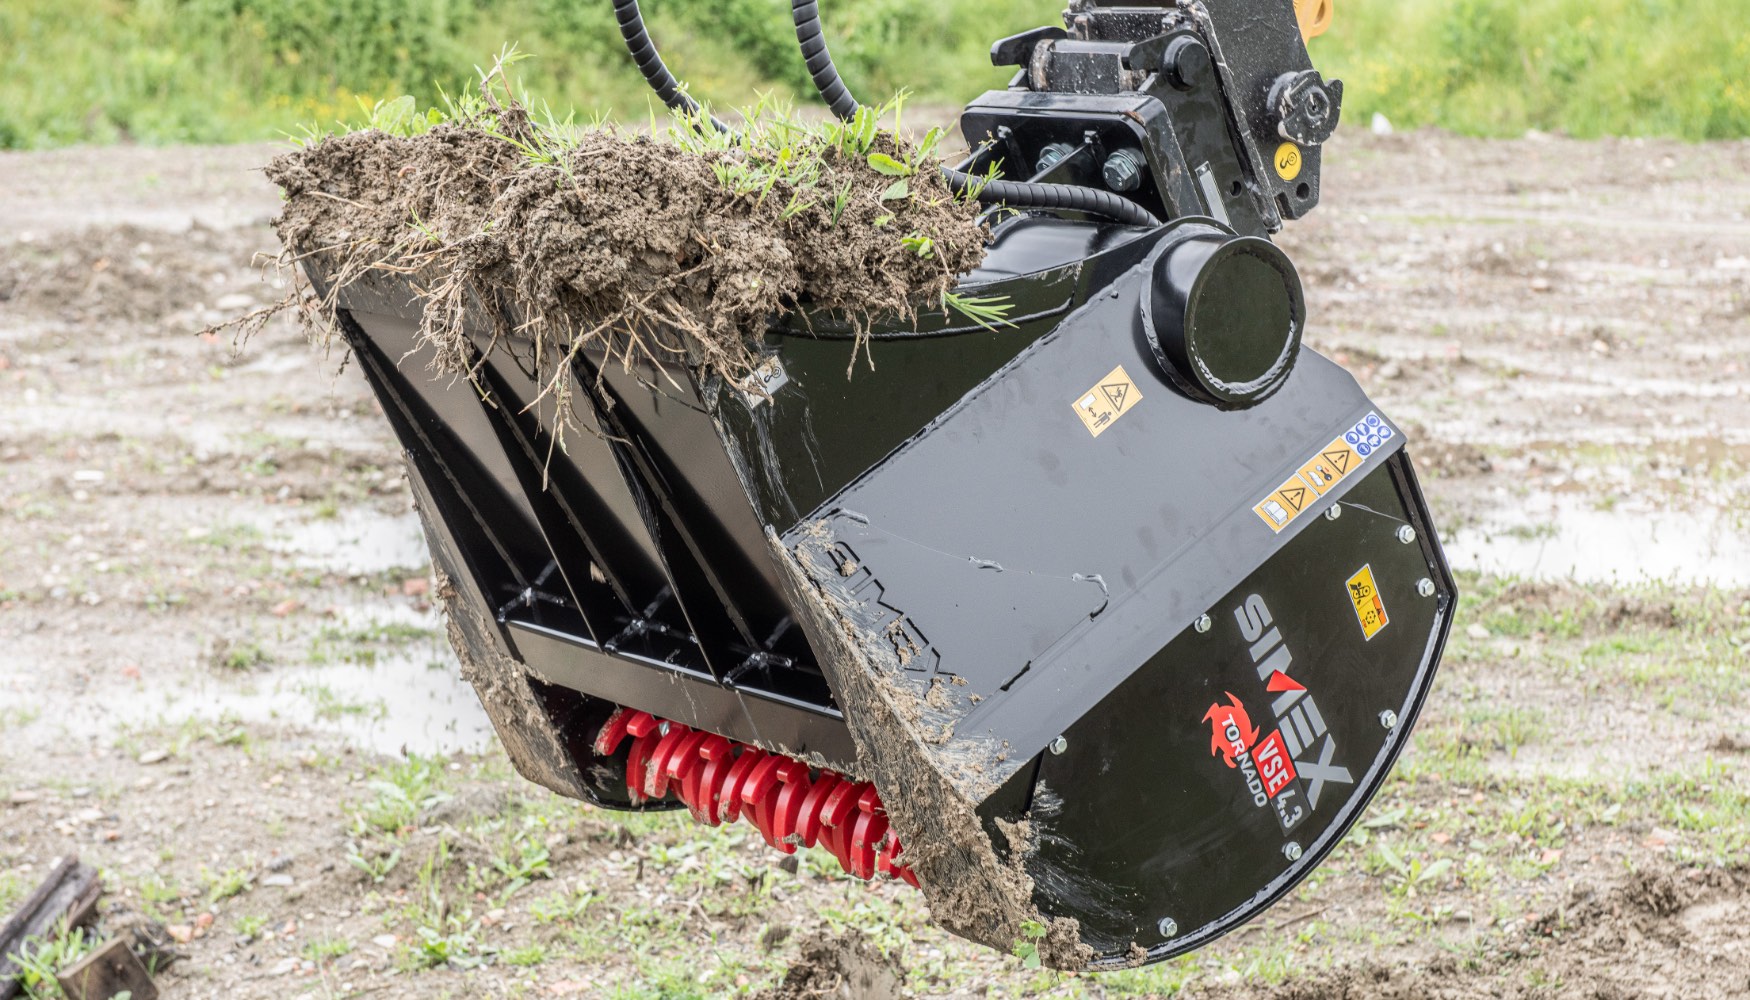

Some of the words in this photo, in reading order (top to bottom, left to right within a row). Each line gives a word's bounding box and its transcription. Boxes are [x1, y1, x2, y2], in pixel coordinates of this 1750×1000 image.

[1234, 594, 1353, 811] SIMEX
[1221, 713, 1268, 808] TORNADO
[1257, 738, 1290, 794] VSE
[1276, 788, 1303, 829] 4.3
